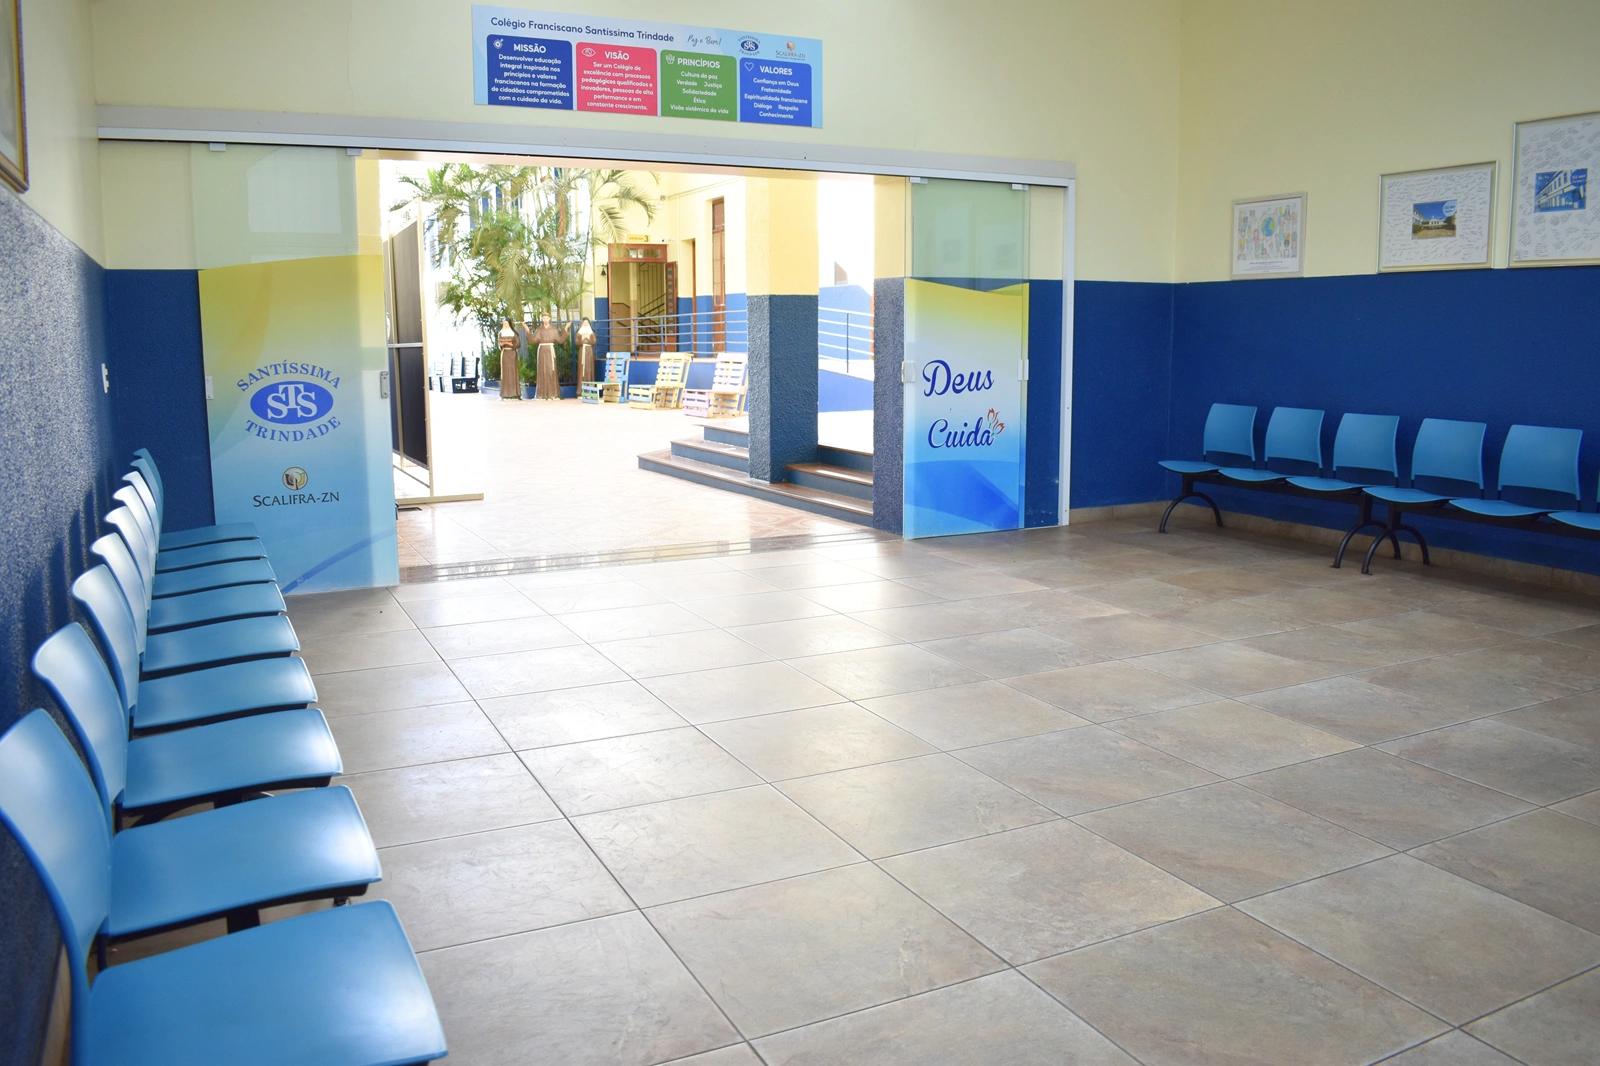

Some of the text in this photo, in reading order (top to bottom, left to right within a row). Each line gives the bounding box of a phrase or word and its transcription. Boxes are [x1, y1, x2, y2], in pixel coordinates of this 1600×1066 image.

[491, 17, 674, 42] Colégio Franciscano Santíssima Trindade
[687, 35, 698, 46] Paz
[706, 36, 722, 46] Bem!
[514, 43, 546, 53] MISSÃO
[605, 50, 629, 61] VISÃO
[500, 62, 522, 70] integral
[677, 58, 720, 69] PRINCÍPIOS
[504, 71, 531, 79] princípios
[760, 66, 792, 75] VALORES
[582, 78, 616, 86] pedagógicos
[745, 94, 780, 102] Espiritualidade
[237, 360, 341, 392] SANTÍSSIMA
[922, 360, 994, 396] Deus
[267, 384, 318, 419] STS
[245, 416, 341, 442] TRINDADE
[928, 417, 994, 448] Cuida
[253, 492, 339, 507] SCALIFRA-ZN
